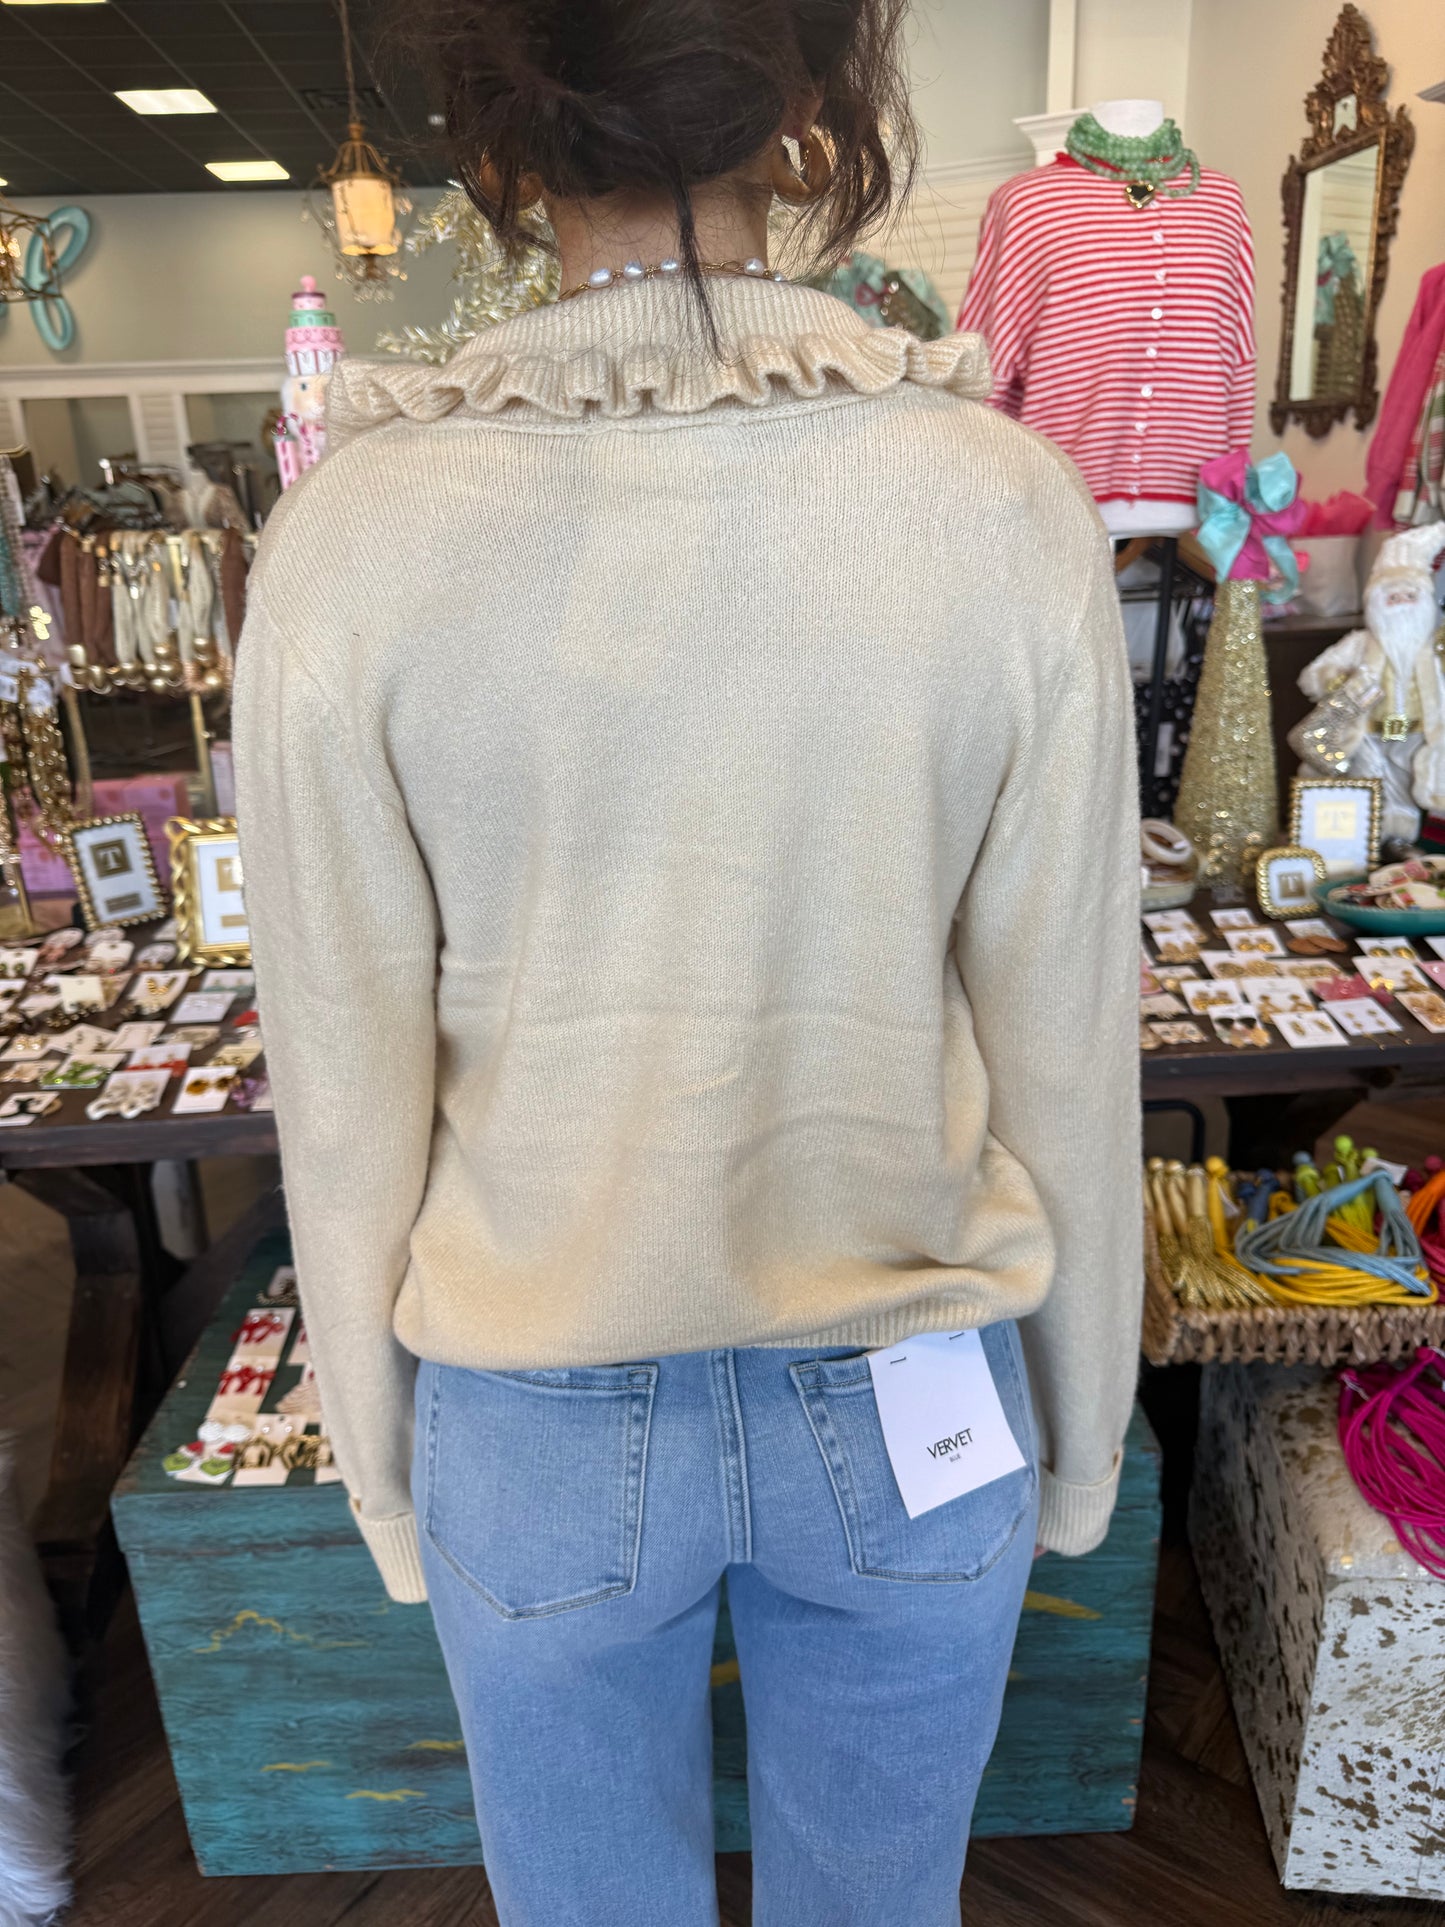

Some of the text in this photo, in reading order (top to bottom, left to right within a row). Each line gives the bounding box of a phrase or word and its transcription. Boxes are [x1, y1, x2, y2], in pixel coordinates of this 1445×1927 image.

[97, 846, 122, 870] T
[1281, 875, 1299, 892] T
[926, 1427, 973, 1459] VERVET
